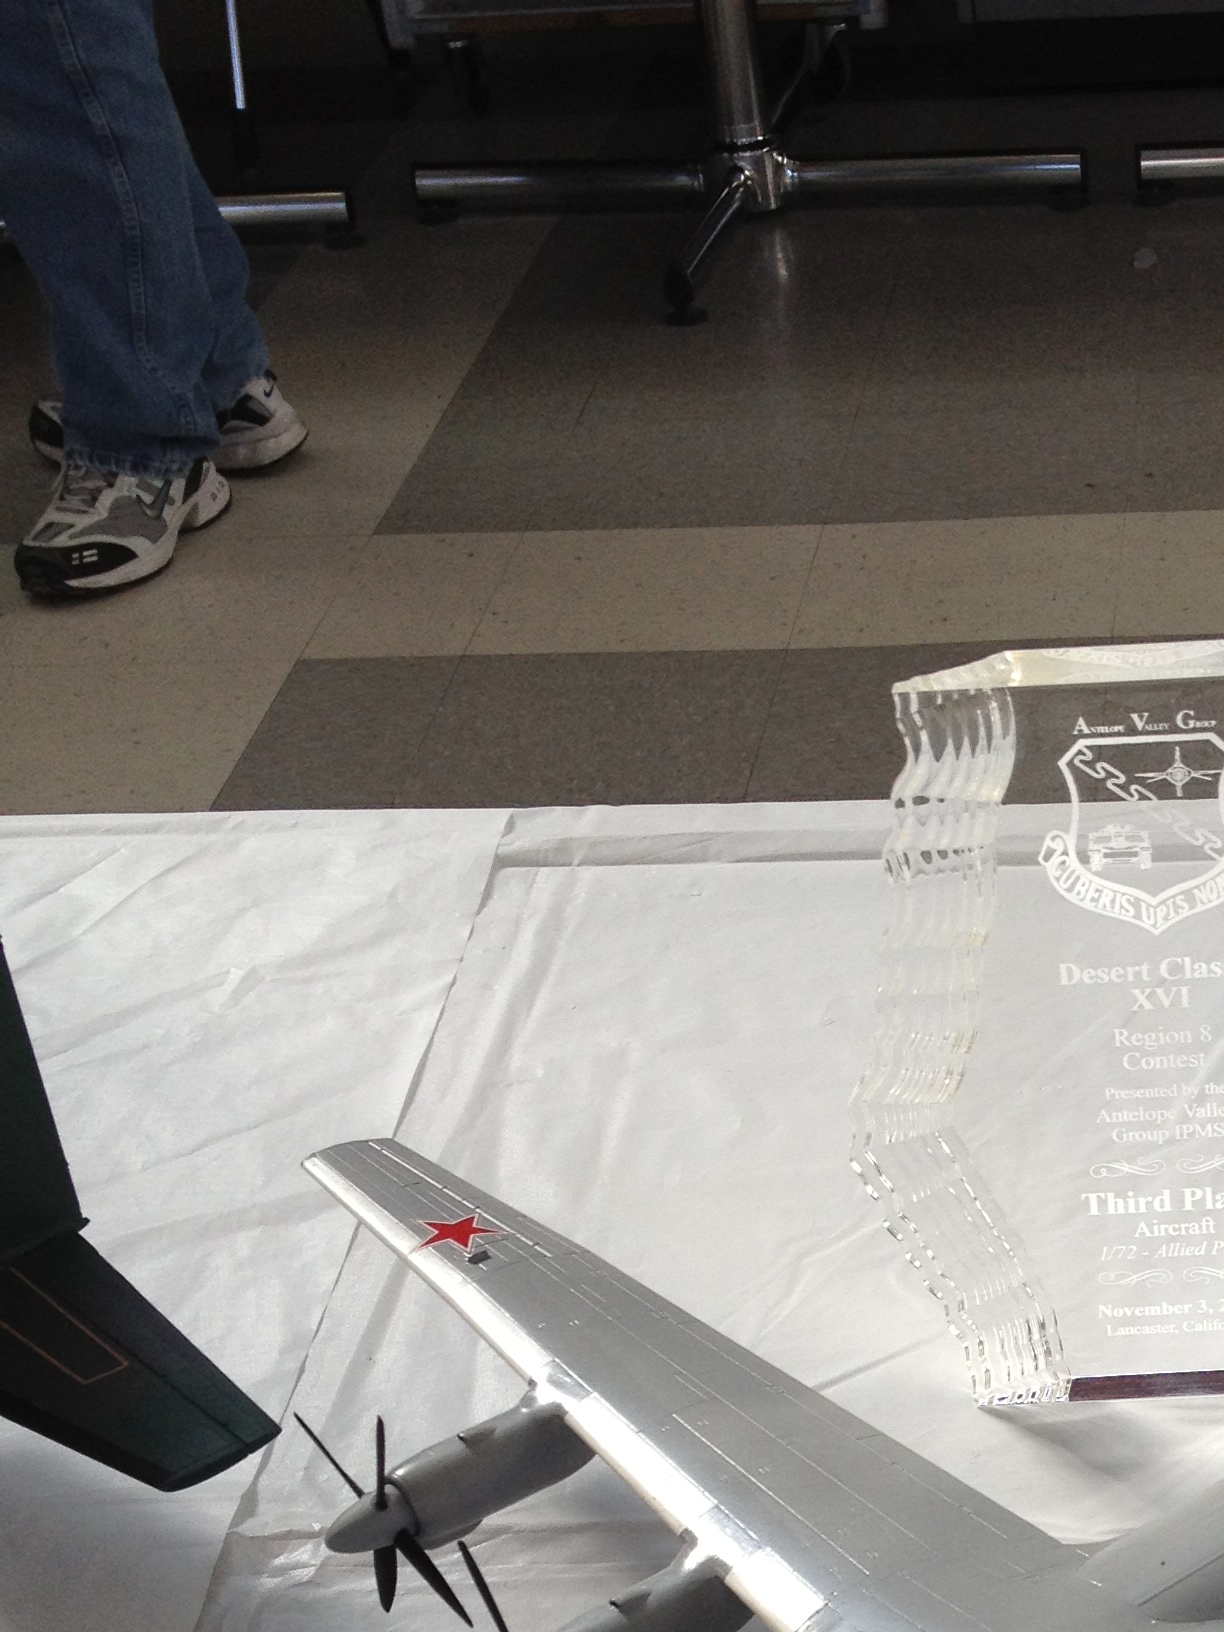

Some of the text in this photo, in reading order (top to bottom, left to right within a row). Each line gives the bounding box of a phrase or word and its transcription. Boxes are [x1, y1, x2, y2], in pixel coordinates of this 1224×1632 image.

[1057, 962, 1151, 985] Desert
[1130, 986, 1192, 1012] XVI
[1113, 1024, 1213, 1050] Region 8
[1122, 1050, 1206, 1071] Contest
[1105, 1084, 1177, 1100] Presented
[1182, 1084, 1200, 1102] by
[1096, 1105, 1178, 1127] Antelope
[1111, 1122, 1224, 1145] Group IPMS
[1081, 1188, 1172, 1216] Third
[1134, 1216, 1216, 1238] Aircraft
[1100, 1245, 1137, 1261] 1/72
[1154, 1243, 1206, 1258] Allied
[1098, 1300, 1193, 1318] November
[1197, 1299, 1214, 1316] 3,
[1106, 1322, 1180, 1337] Lancaster,
